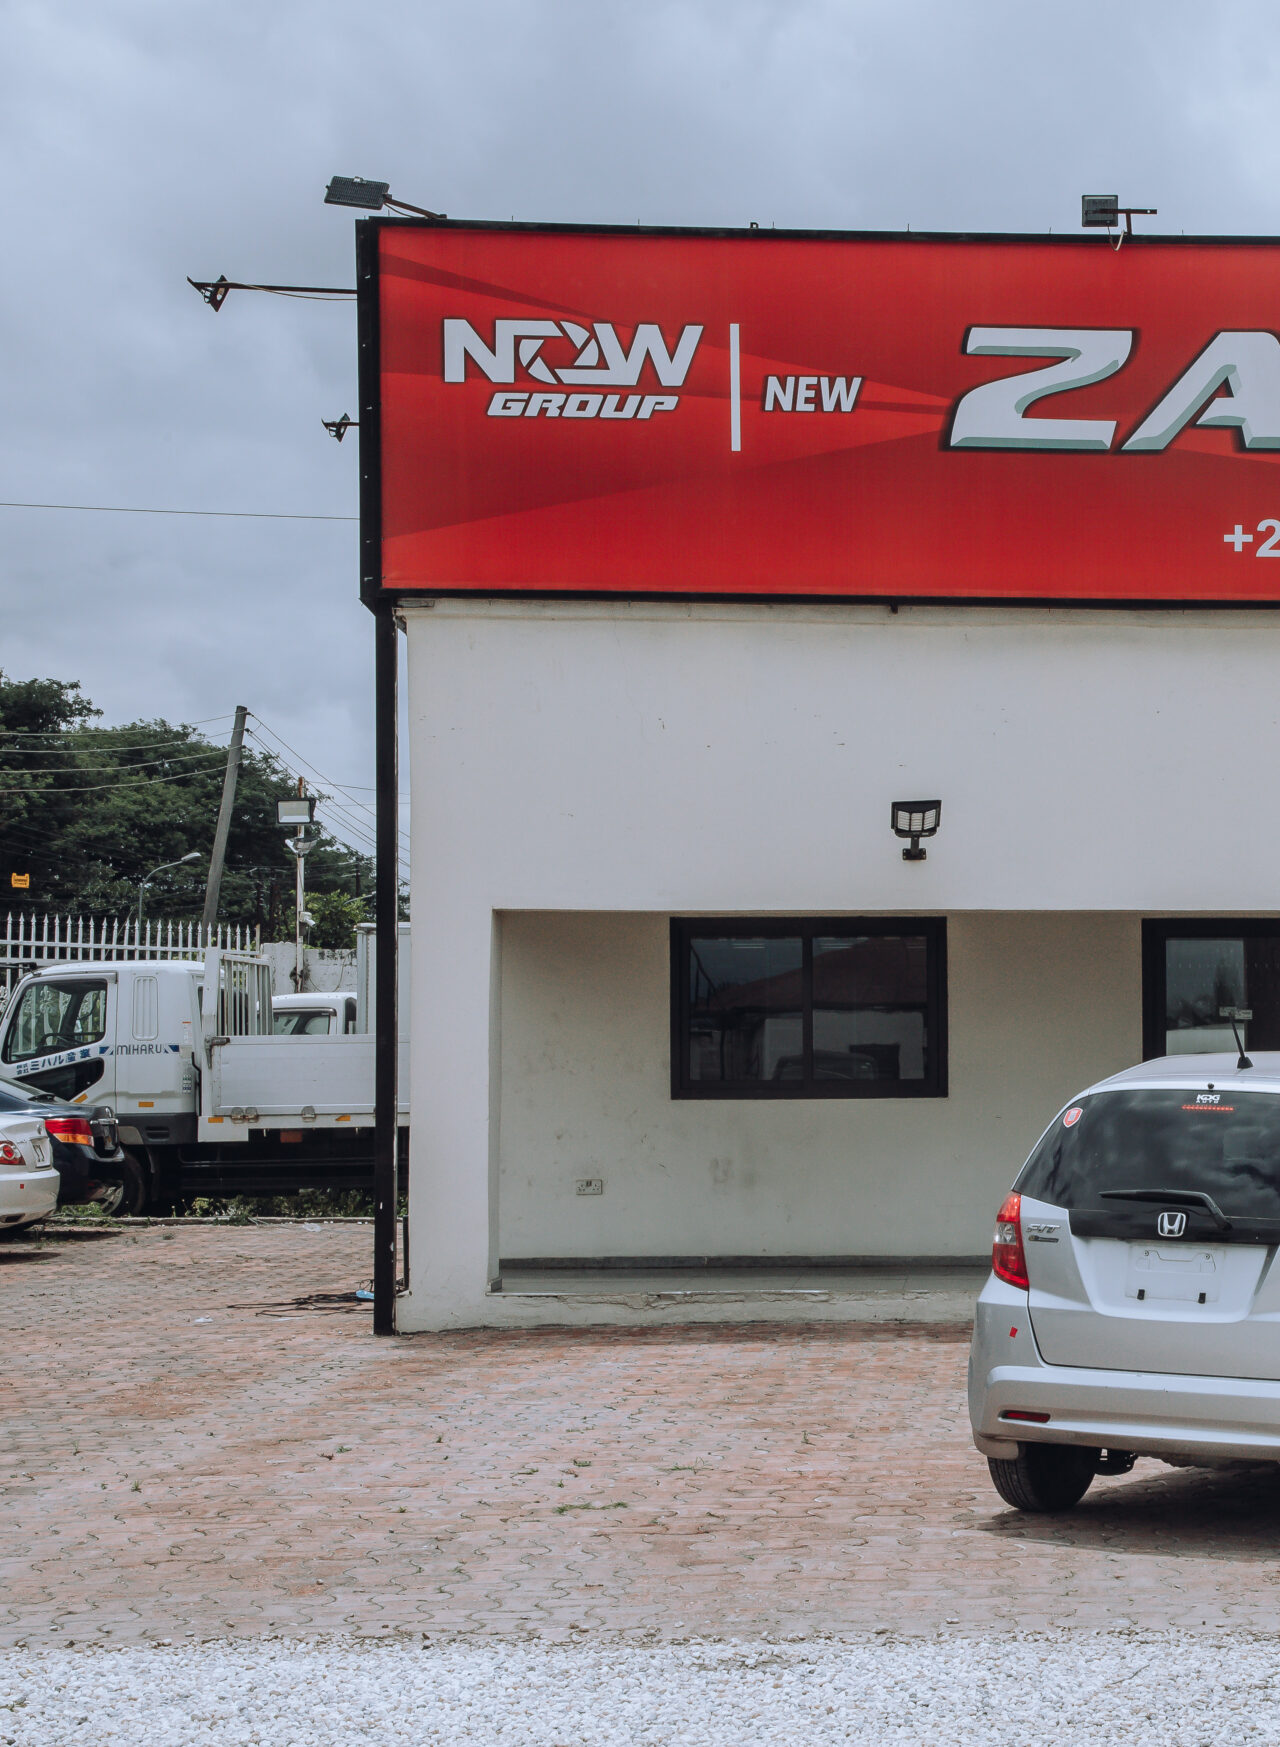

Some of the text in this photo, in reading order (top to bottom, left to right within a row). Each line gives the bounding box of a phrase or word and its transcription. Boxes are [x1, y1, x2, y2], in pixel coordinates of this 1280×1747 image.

[487, 392, 679, 419] GROUP
[764, 375, 862, 412] NEW
[116, 1044, 162, 1055] MIHARU
